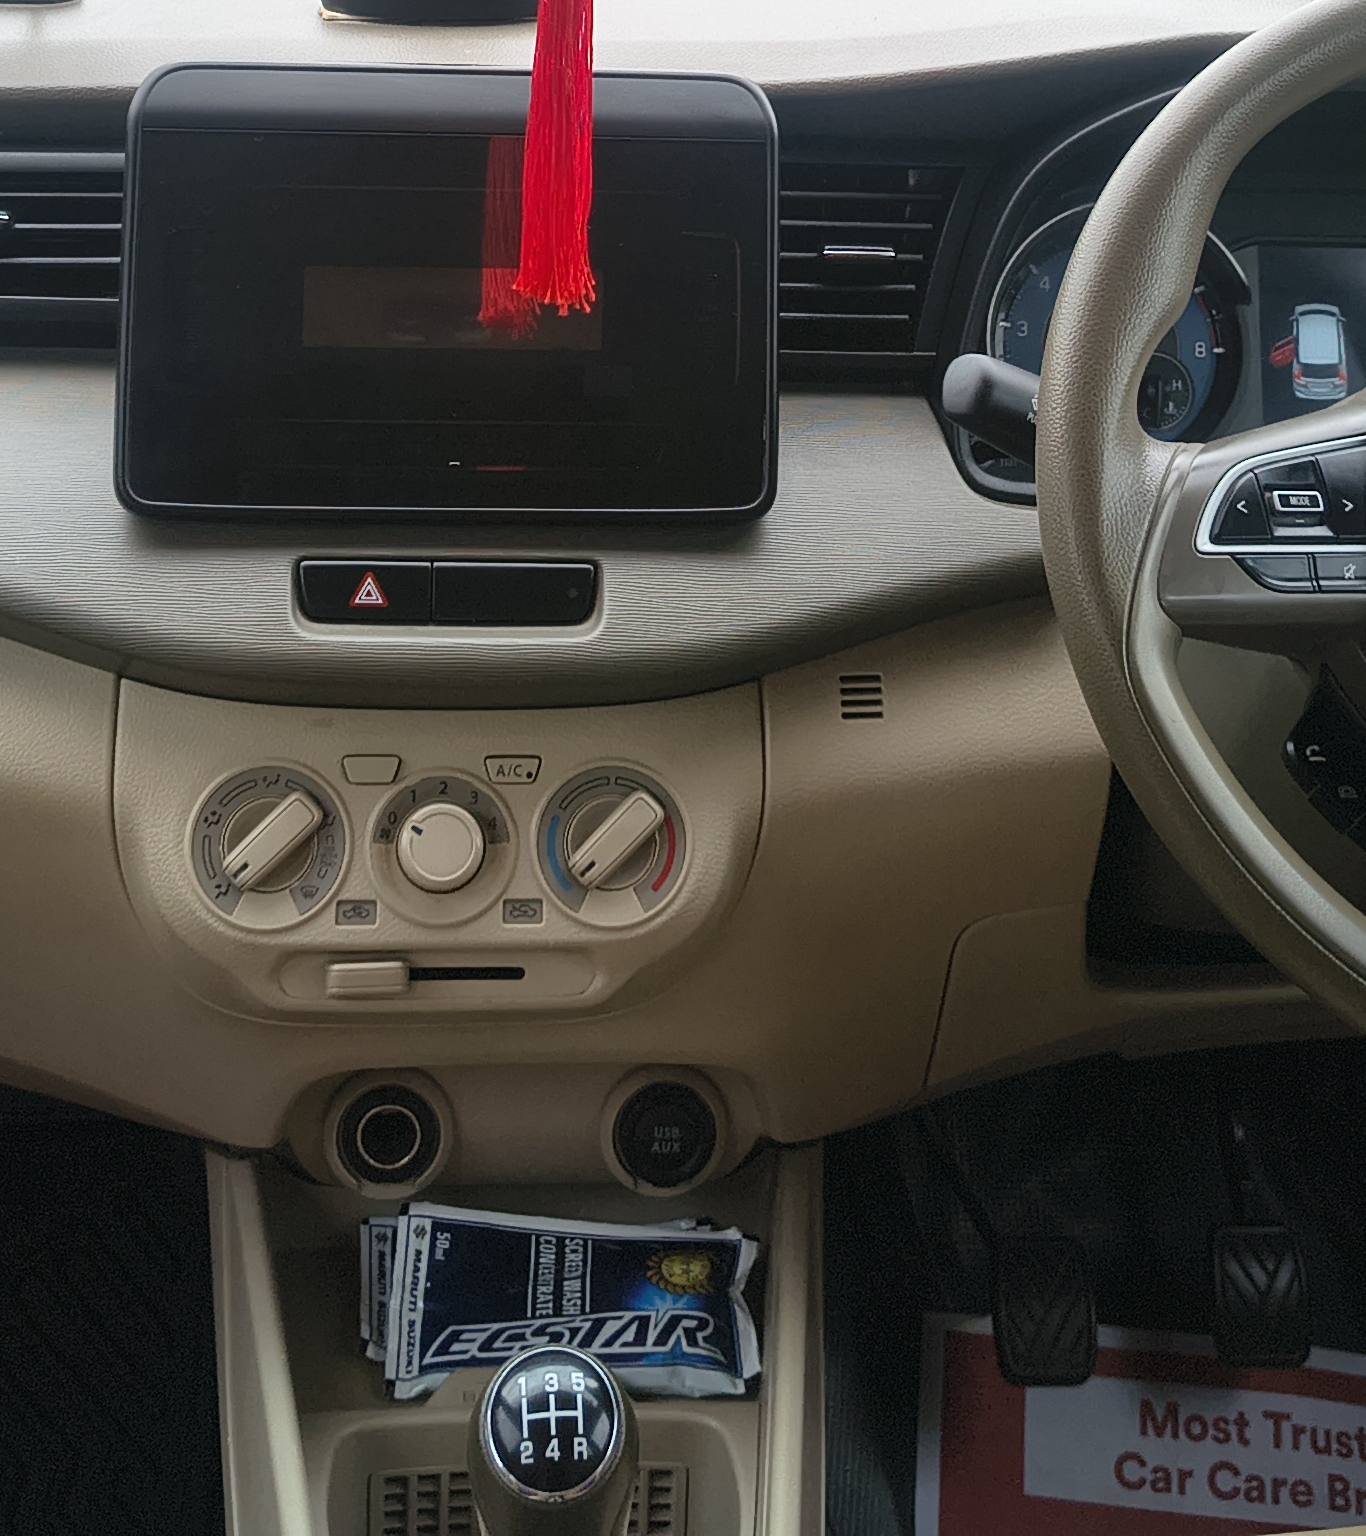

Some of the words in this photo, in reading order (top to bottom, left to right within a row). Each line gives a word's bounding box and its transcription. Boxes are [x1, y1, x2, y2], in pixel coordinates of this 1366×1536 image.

[1039, 275, 1051, 292] 4
[1016, 320, 1028, 337] 3
[1194, 342, 1206, 358] 8
[1172, 379, 1182, 391] H
[1289, 496, 1311, 507] MODE
[496, 764, 522, 778] A/C
[439, 781, 449, 795] 2
[410, 790, 417, 804] 1
[469, 791, 479, 805] 3
[388, 811, 397, 825] 0
[488, 816, 497, 830] 4
[654, 1125, 680, 1138] USB
[651, 1141, 681, 1154] AUX
[408, 1249, 423, 1313] MARUTI
[423, 1310, 727, 1366] ECSTAR
[405, 1318, 417, 1375] SUZUKI
[517, 1376, 527, 1396] 1
[544, 1372, 559, 1392] 3
[570, 1372, 585, 1392] 5
[1139, 1397, 1252, 1448] Most
[520, 1440, 534, 1464] 2
[545, 1437, 561, 1461] 4
[573, 1436, 588, 1460] R
[1114, 1450, 1195, 1496] Car
[1207, 1460, 1316, 1509] Care
